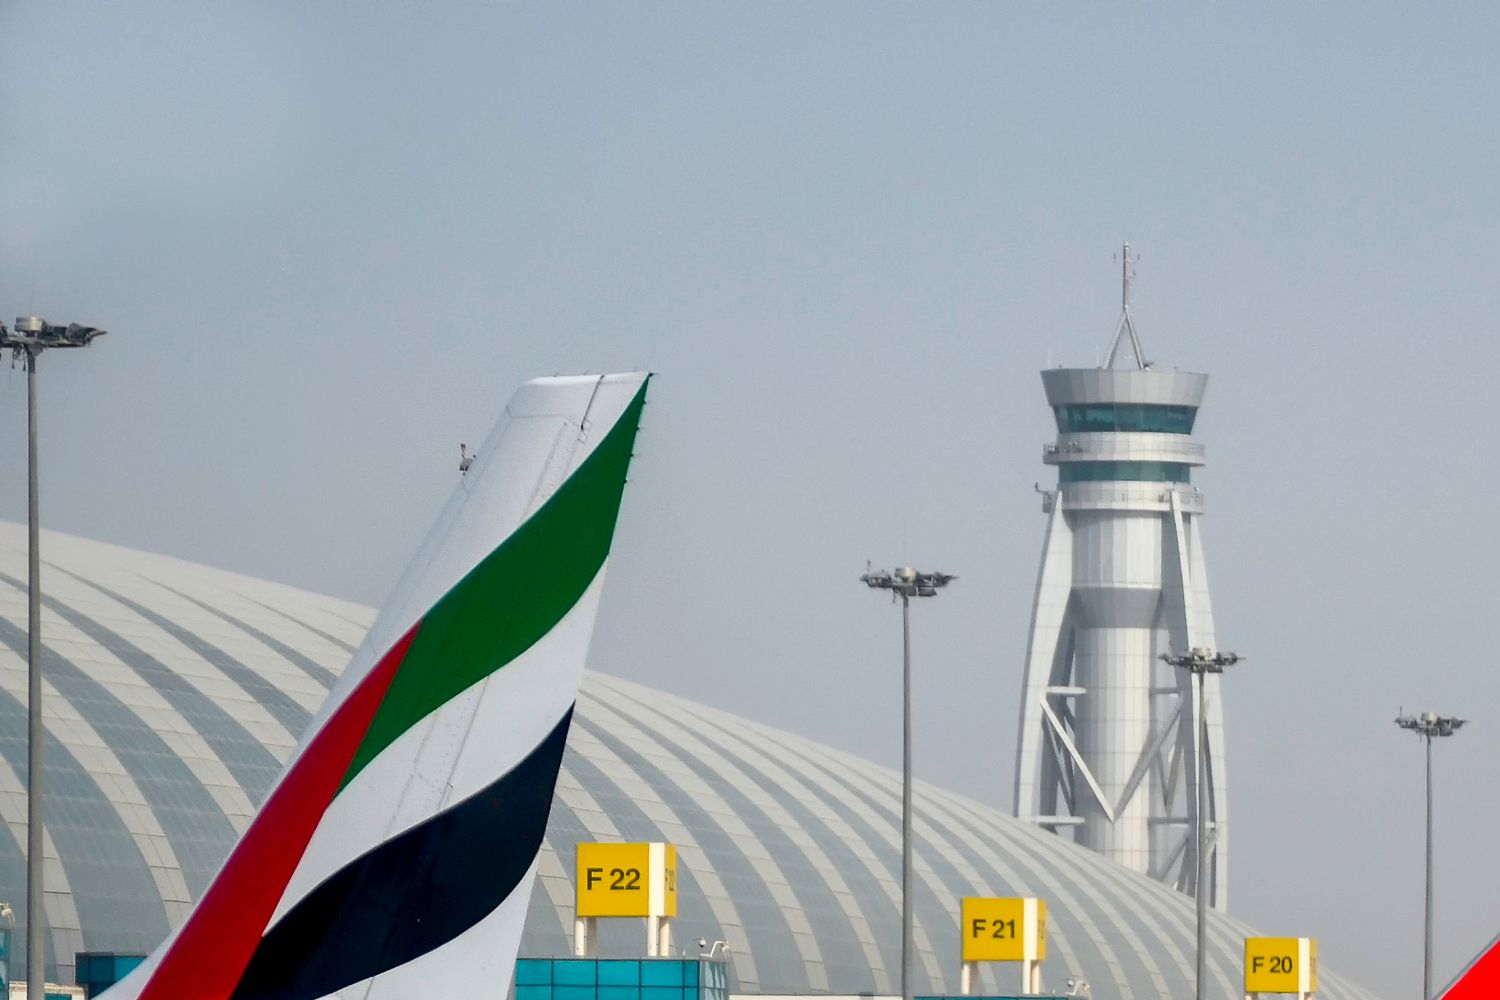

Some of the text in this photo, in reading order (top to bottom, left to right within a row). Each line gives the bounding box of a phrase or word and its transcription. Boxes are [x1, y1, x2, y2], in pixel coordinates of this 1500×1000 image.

[587, 867, 603, 891] F
[609, 867, 641, 891] 22
[972, 918, 987, 939] F
[991, 918, 1016, 940] 21
[1252, 956, 1265, 974] F
[1269, 955, 1293, 974] 20
